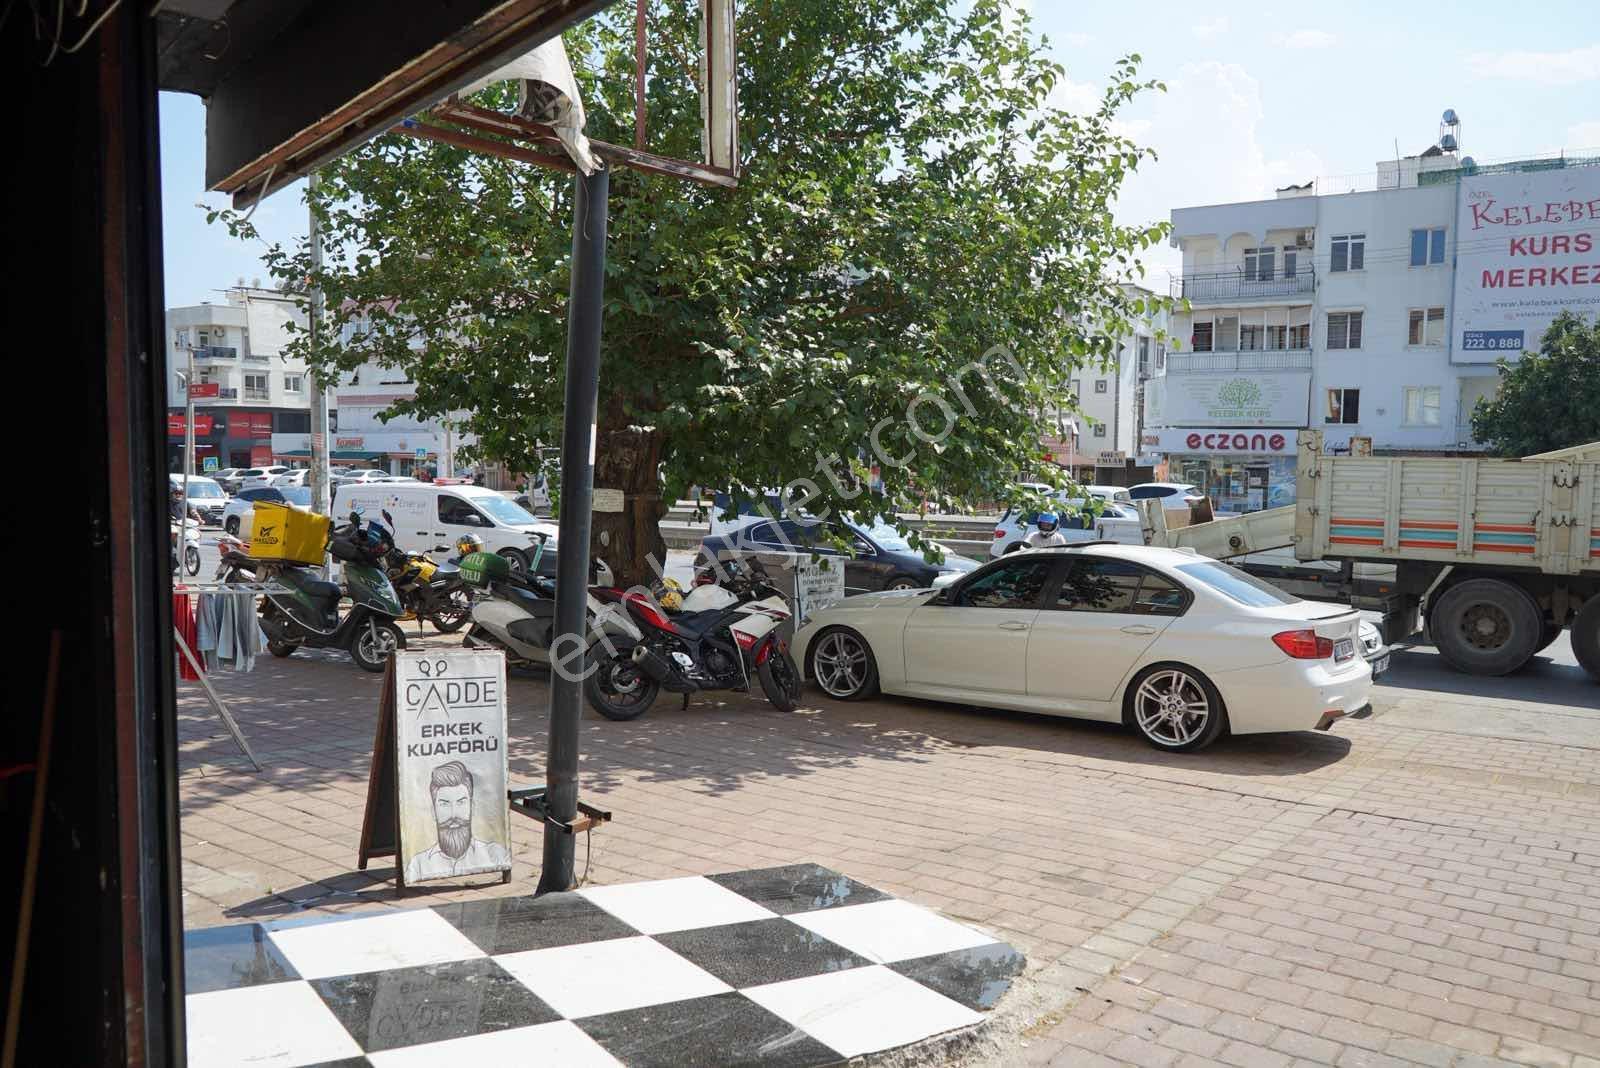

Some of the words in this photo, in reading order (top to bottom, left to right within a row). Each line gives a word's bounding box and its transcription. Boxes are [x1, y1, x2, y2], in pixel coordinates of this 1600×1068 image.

[1510, 233, 1592, 256] KURS
[1465, 338, 1485, 349] 222
[1488, 338, 1496, 349] 0
[1499, 337, 1521, 349] 888
[1186, 433, 1285, 450] eczane
[406, 681, 497, 720] CADDE
[421, 722, 483, 738] ERKEK
[407, 736, 498, 757] KUAFÖRÜ
